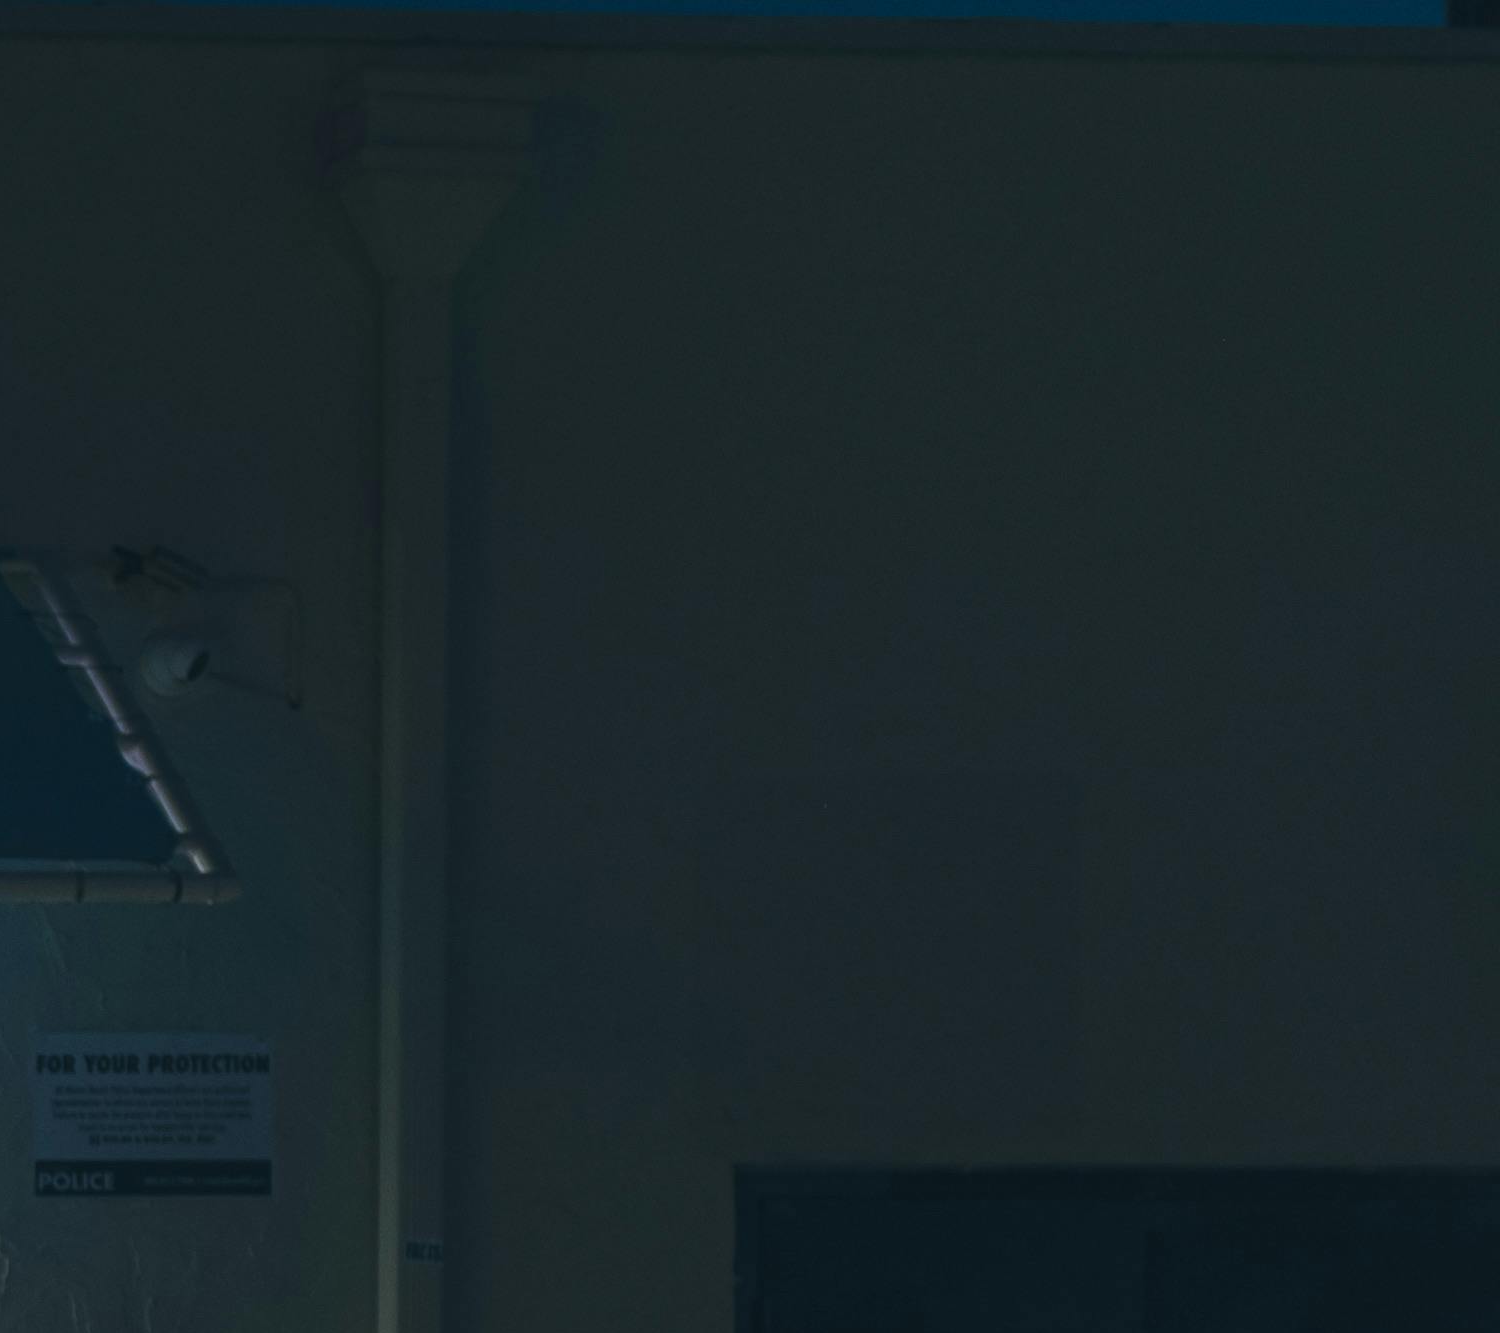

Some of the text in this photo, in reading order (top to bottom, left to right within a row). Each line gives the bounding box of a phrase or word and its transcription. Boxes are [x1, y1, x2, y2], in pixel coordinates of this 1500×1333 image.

[36, 1054, 270, 1073] FOR YOUR PROTECTION
[38, 1171, 115, 1191] POLICE
